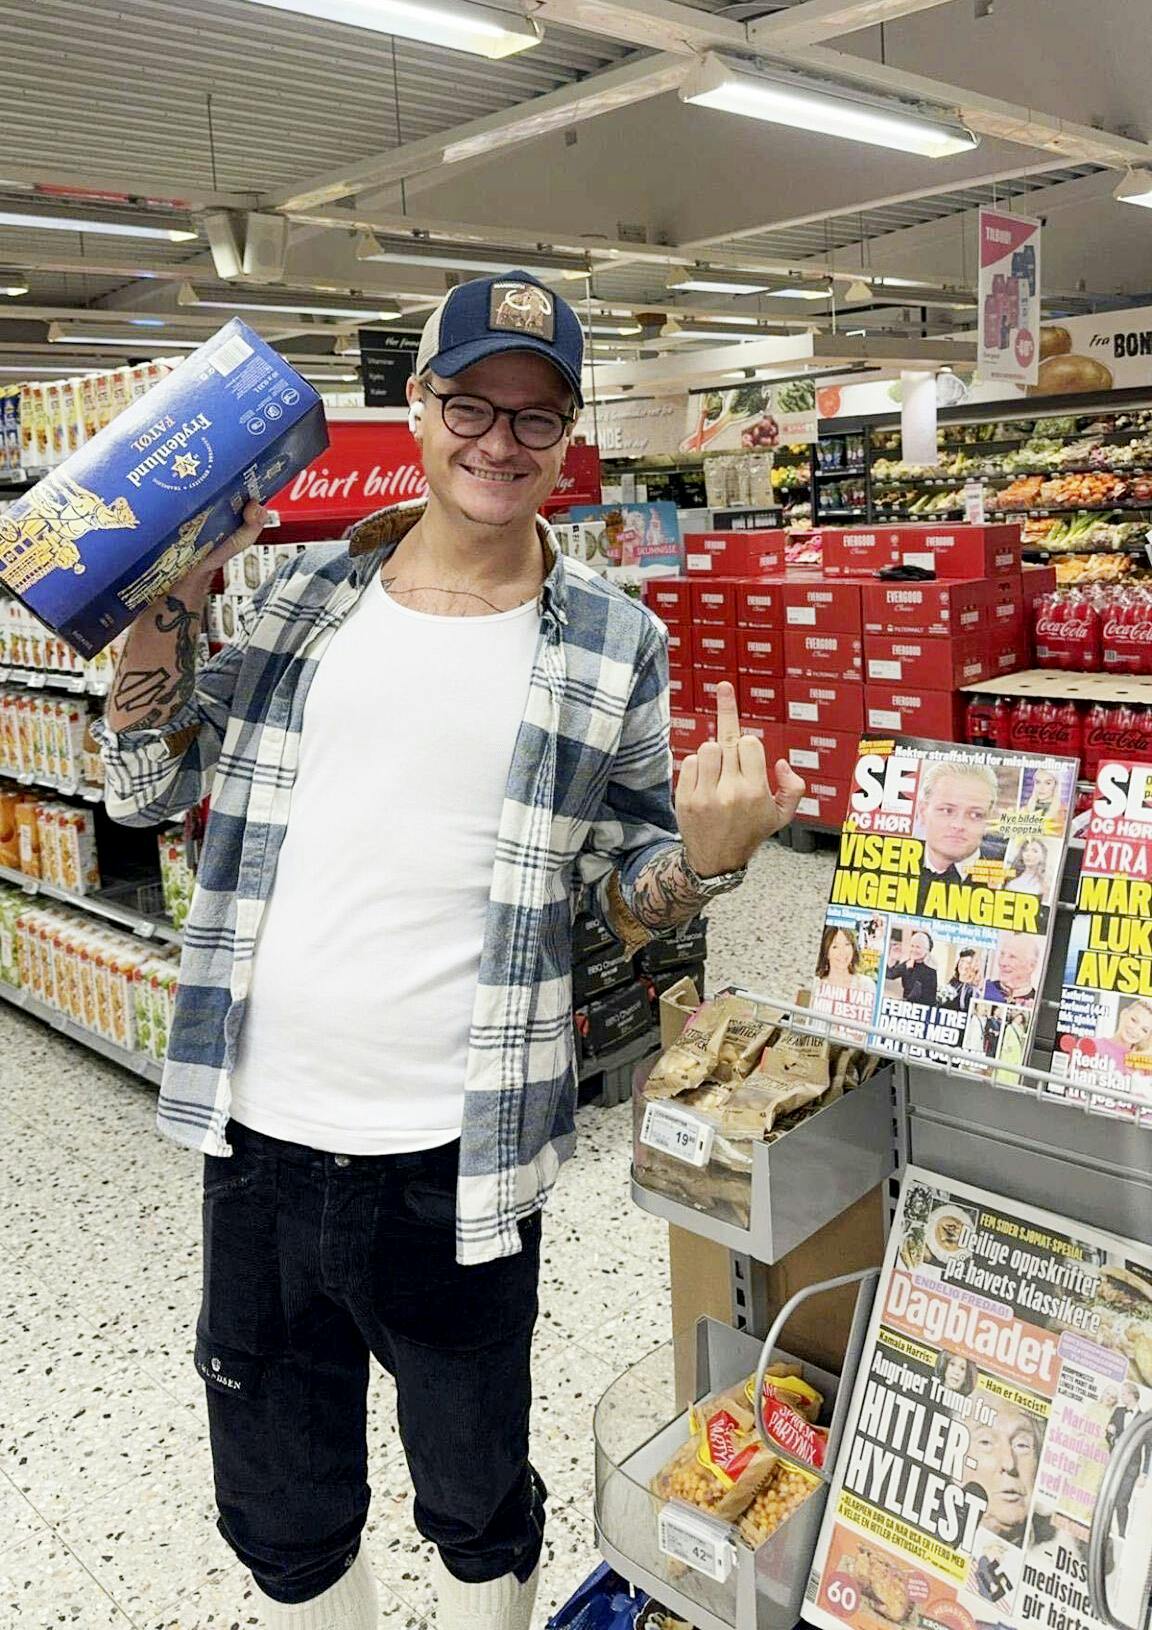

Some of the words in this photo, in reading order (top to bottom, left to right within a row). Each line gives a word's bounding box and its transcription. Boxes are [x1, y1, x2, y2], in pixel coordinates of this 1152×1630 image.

[1089, 334, 1110, 348] Fra
[130, 414, 176, 453] FATØL
[126, 413, 213, 489] Frydenlund
[290, 468, 356, 500] Vårt
[842, 535, 876, 547] EVERGOOD
[925, 536, 955, 547] EVERGOOD
[887, 590, 923, 604] EVERGOOD
[805, 636, 838, 651] EVERGOOD
[892, 645, 921, 657] EVERGOOD
[892, 695, 921, 708] EVERGOOD
[851, 754, 920, 814] SE
[874, 815, 912, 834] HØR
[1000, 812, 1018, 824] Nye
[1018, 813, 1045, 824] bilder
[1000, 824, 1011, 834] og
[1012, 825, 1043, 835] opptak
[1091, 818, 1116, 835] OG
[840, 833, 925, 876] VISER
[1084, 840, 1148, 875] EXTRA
[831, 869, 920, 916] INGEN
[922, 881, 1041, 934] ANGER
[1089, 914, 1152, 956] LUK
[833, 1001, 873, 1023] BESTE
[849, 989, 875, 1007] VAR
[881, 998, 930, 1023] FEIRET
[937, 1009, 967, 1030] TRE
[879, 1015, 926, 1040] DAGER
[926, 1023, 961, 1046] MED
[1070, 1064, 1097, 1085] han
[1098, 1071, 1133, 1092] skal
[676, 1131, 689, 1147] 19
[979, 1212, 998, 1231] FEM
[996, 1218, 1020, 1239] SIDER
[957, 1224, 1011, 1266] Deilige
[1009, 1248, 1102, 1298] oppskrifter
[914, 1274, 960, 1299] ENDELIG
[960, 1291, 1011, 1318] FREDAG!
[943, 1253, 966, 1281] på
[965, 1260, 1017, 1301] havets
[1017, 1279, 1102, 1334] klassikere
[886, 1274, 1058, 1382] Dagbladet
[878, 1330, 906, 1350] Kamala
[905, 1342, 934, 1363] Harris:
[871, 1350, 930, 1396] Angriper
[929, 1376, 974, 1419] Trump
[975, 1398, 998, 1428] for
[985, 1379, 1003, 1396] Han
[1003, 1388, 1013, 1400] er
[1012, 1390, 1048, 1413] fascist!
[858, 1380, 979, 1482] HITLER-
[1043, 1449, 1082, 1479] hefter
[844, 1435, 989, 1554] HYLLEST
[1040, 1470, 1062, 1494] ved
[861, 1516, 871, 1529] EN
[951, 1553, 966, 1569] MED
[1056, 1545, 1088, 1583] Diss
[827, 1580, 857, 1611] 60
[1022, 1564, 1099, 1621] medisine
[1022, 1593, 1045, 1620] gir
